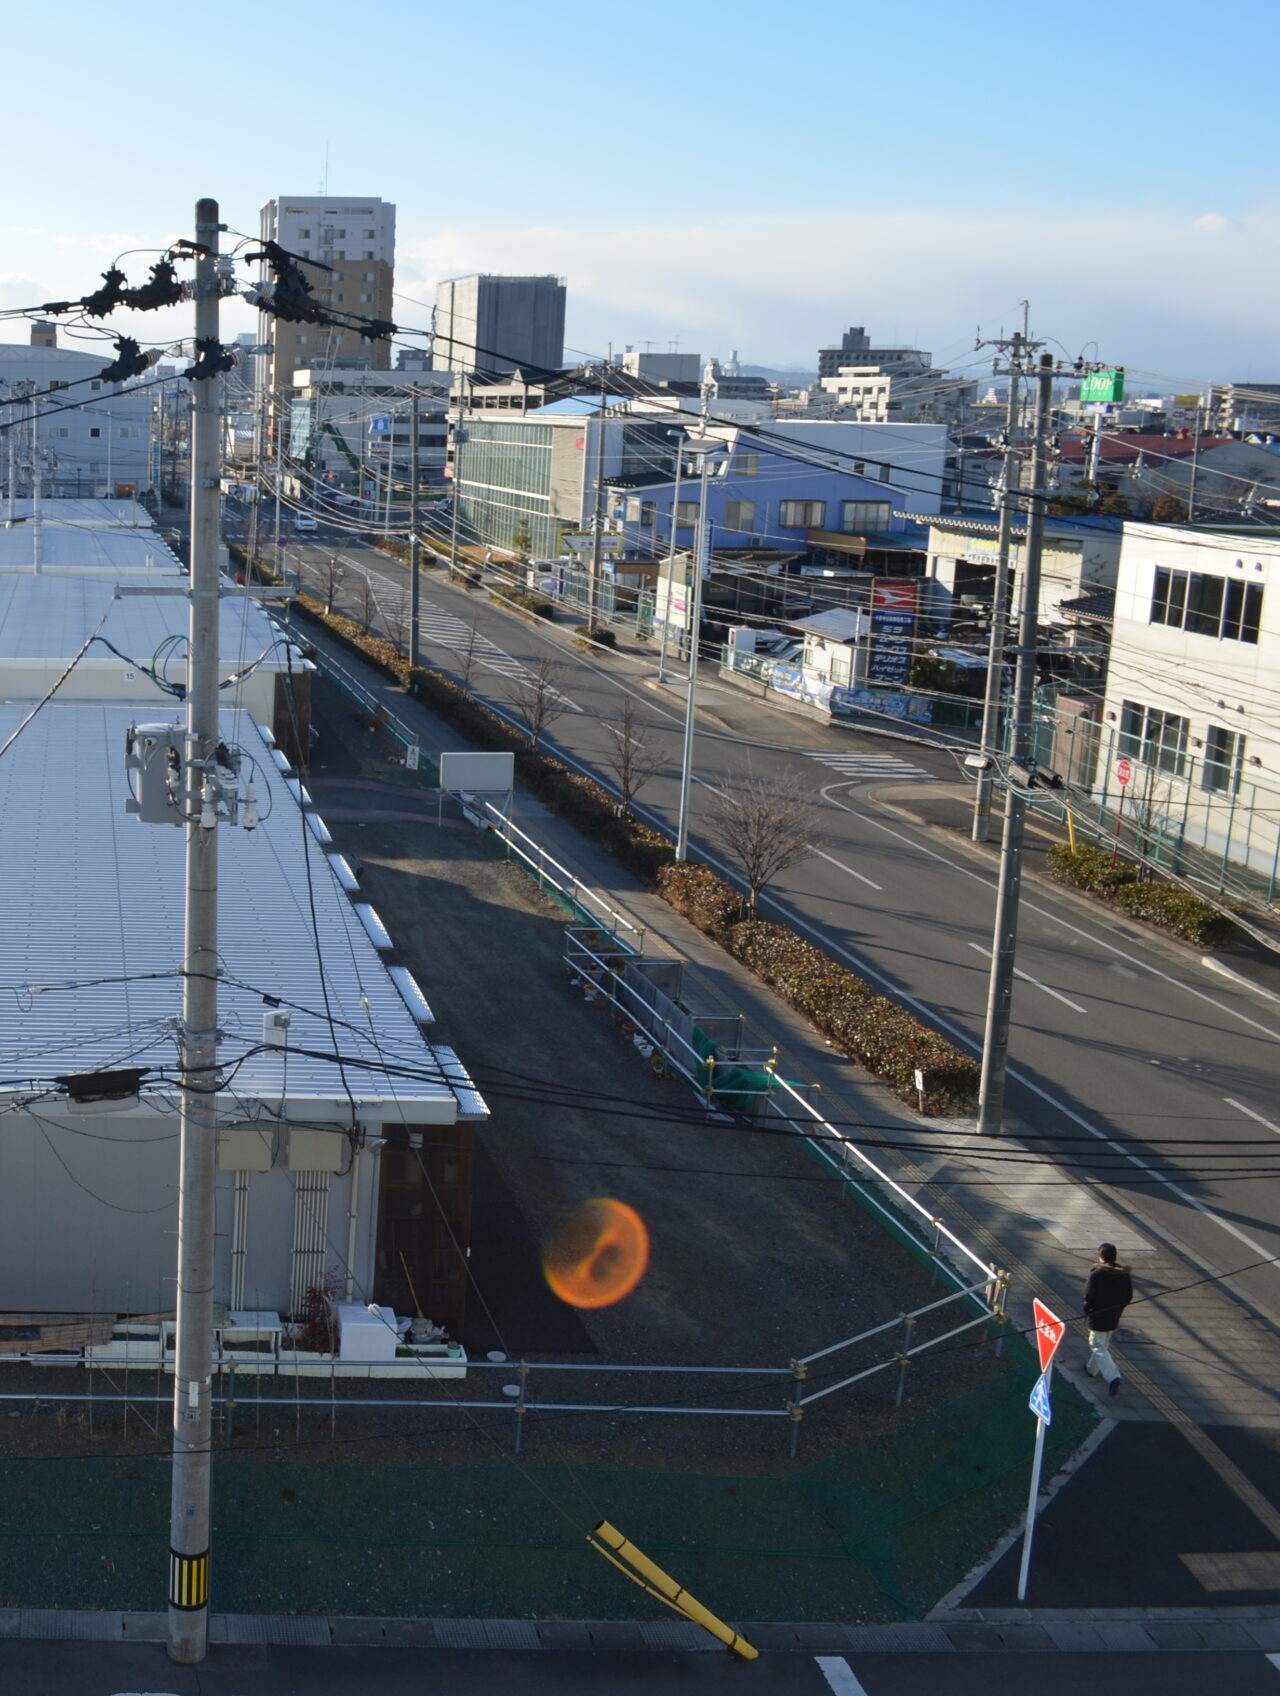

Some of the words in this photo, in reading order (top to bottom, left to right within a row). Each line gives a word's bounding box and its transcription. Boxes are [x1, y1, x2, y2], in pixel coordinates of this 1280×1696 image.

[1082, 376, 1114, 391] COOP
[882, 625, 903, 633] ミラ
[1039, 1318, 1057, 1344] 止まれ
